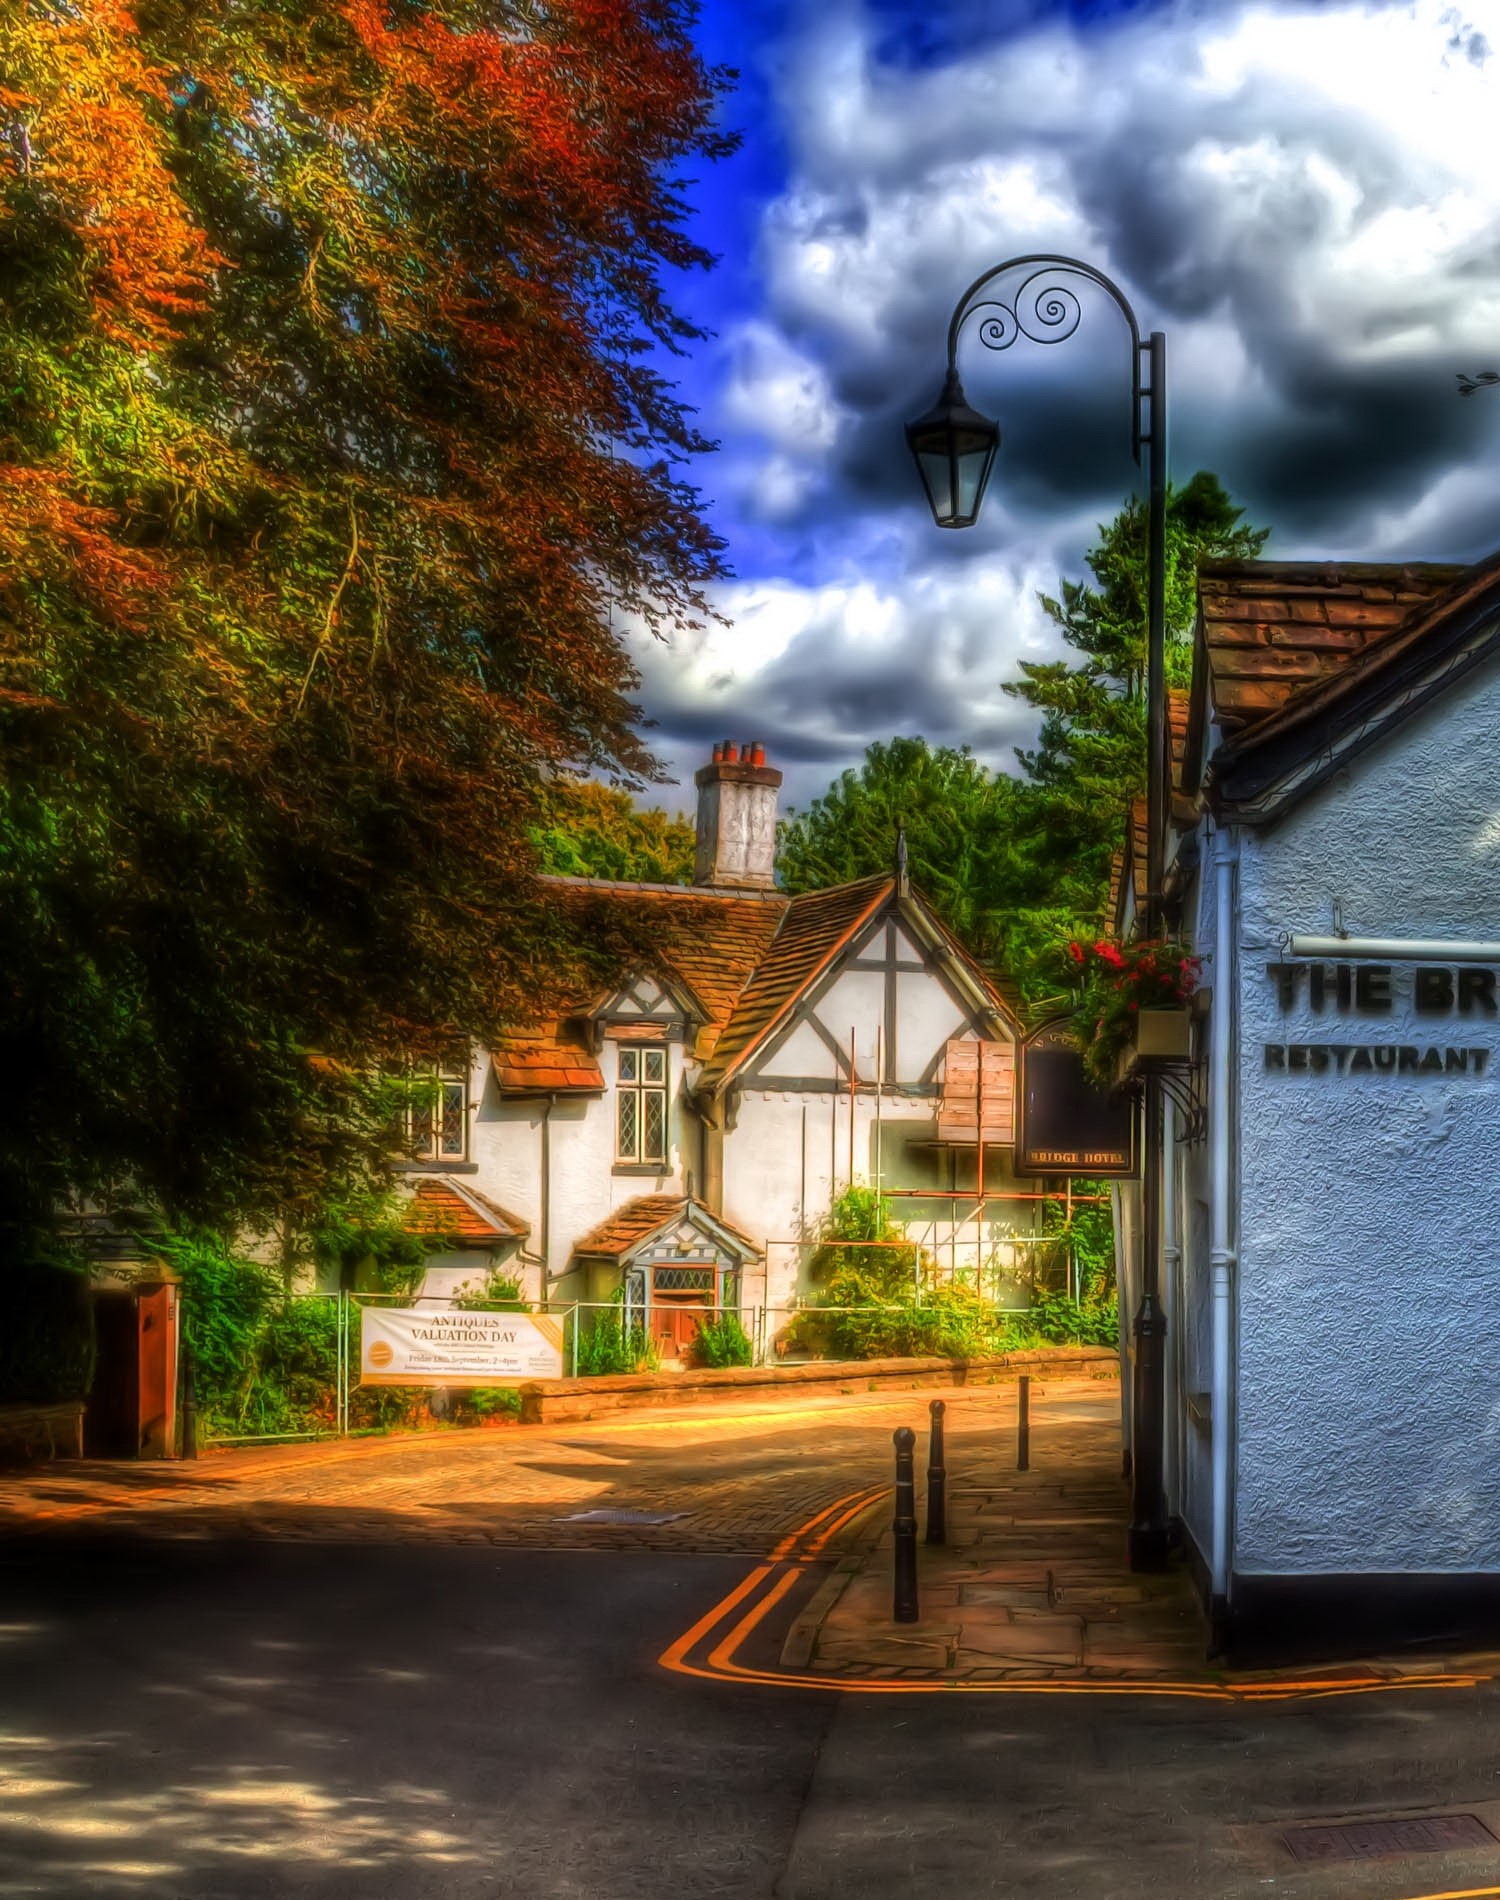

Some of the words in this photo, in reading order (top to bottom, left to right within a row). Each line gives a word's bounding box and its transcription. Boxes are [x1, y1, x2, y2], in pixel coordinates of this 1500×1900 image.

[1266, 963, 1392, 1012] THE
[1264, 1044, 1489, 1073] RESTAURANT
[1031, 1152, 1079, 1163] BRIDGE
[1084, 1152, 1125, 1164] HOTEL
[431, 1316, 499, 1329] ANTIQUES
[411, 1329, 488, 1342] VALUATION
[491, 1329, 517, 1343] DAY
